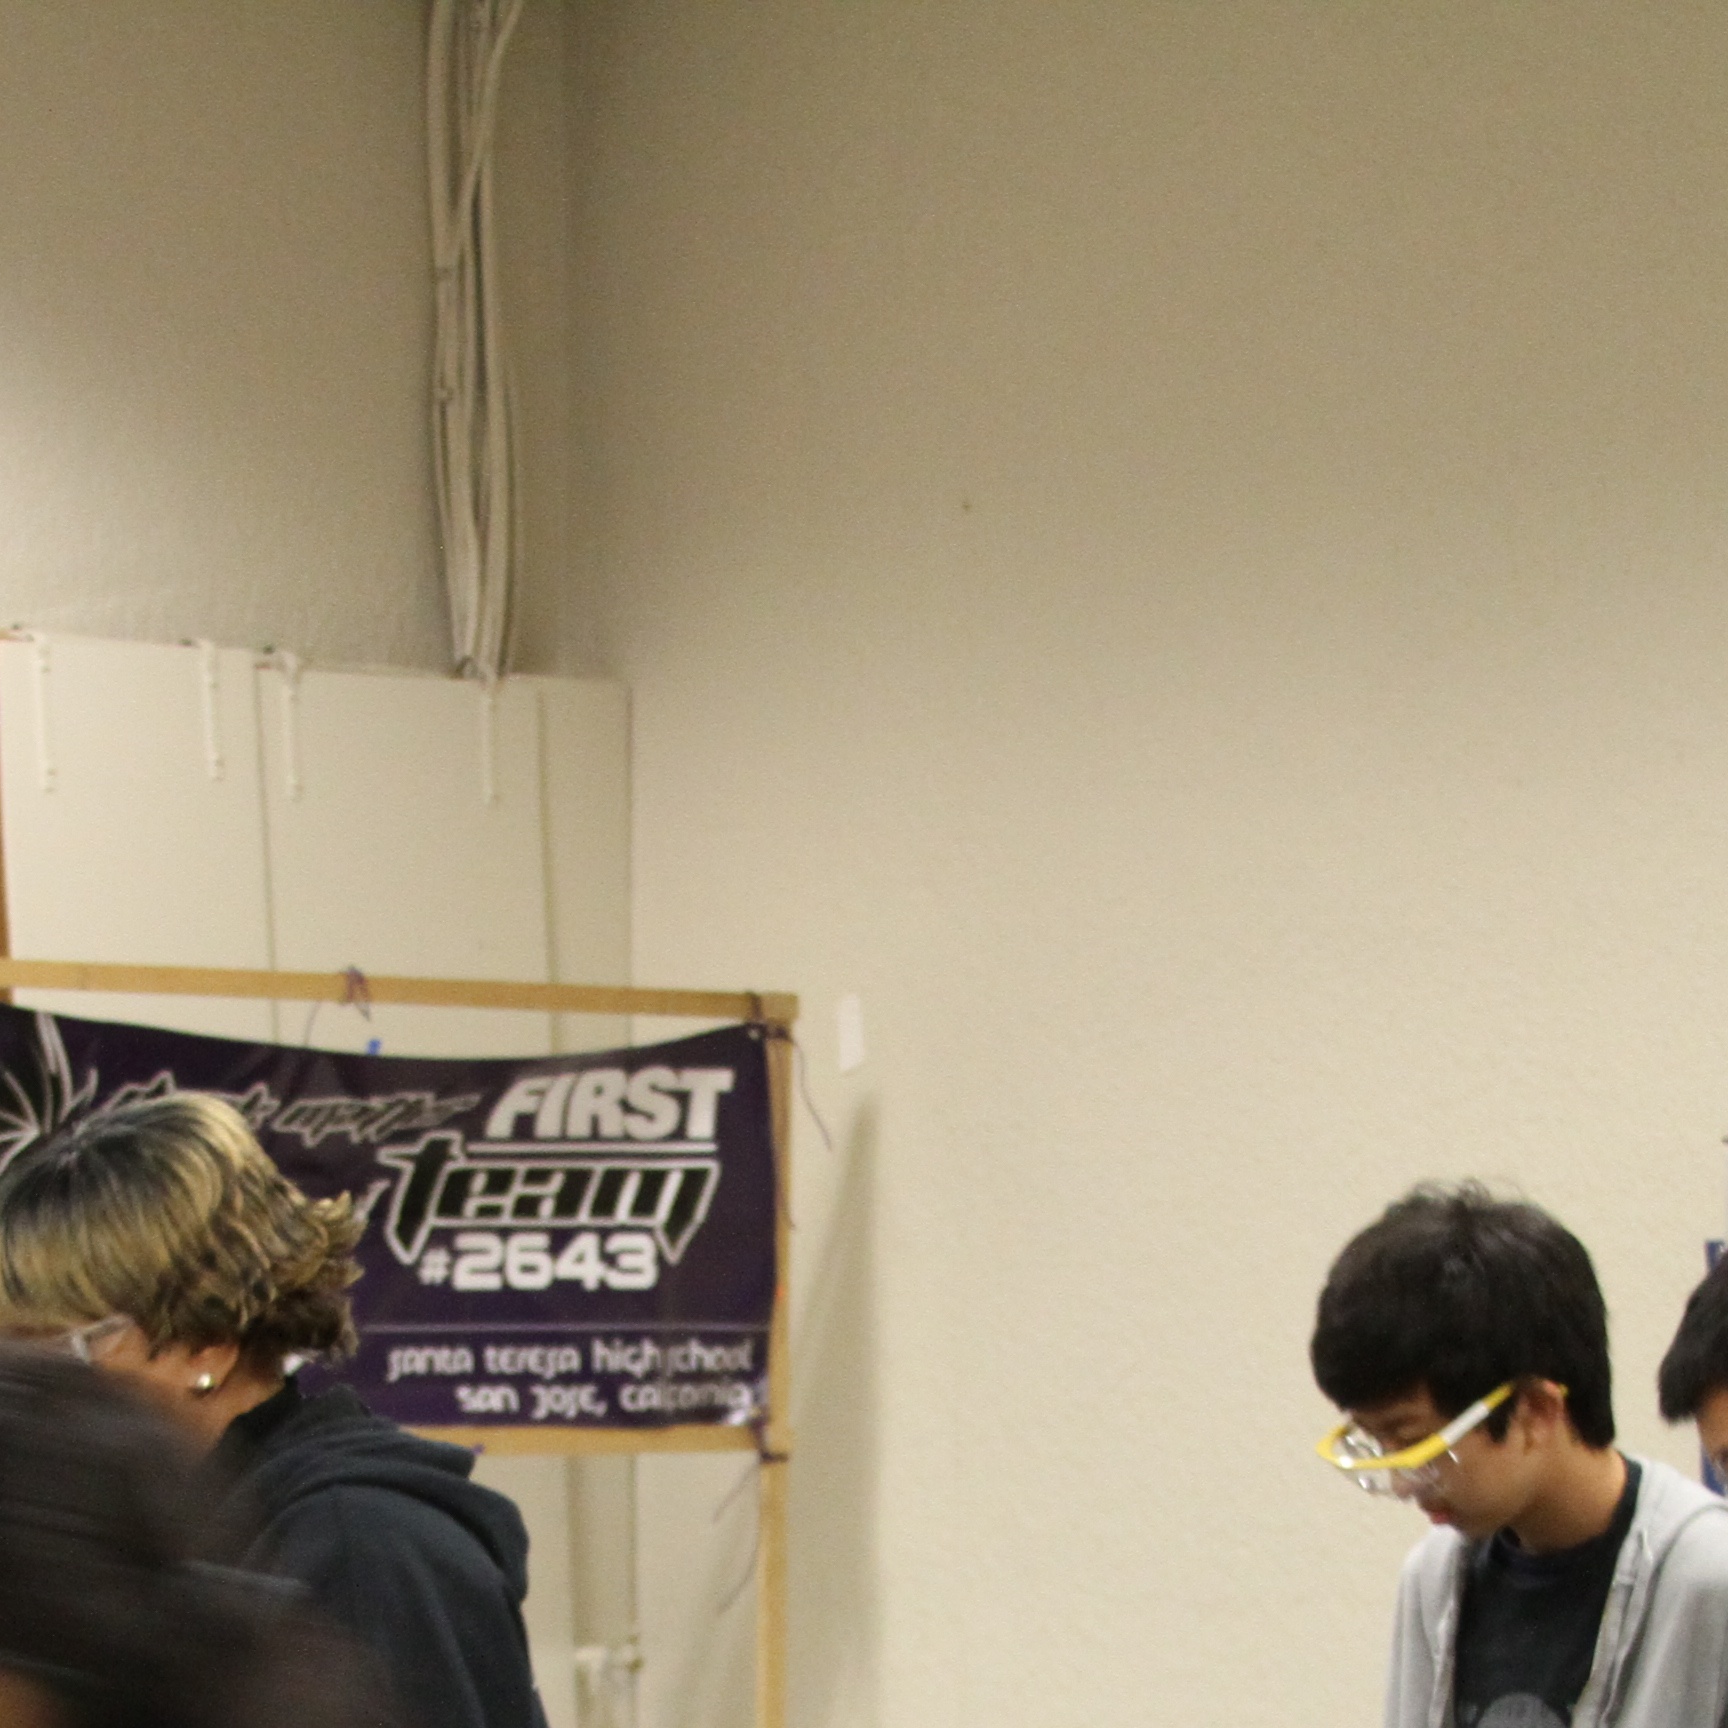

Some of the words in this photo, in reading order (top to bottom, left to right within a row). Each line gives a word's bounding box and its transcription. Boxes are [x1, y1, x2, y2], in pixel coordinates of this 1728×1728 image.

[485, 1066, 734, 1140] FIRST
[377, 1131, 721, 1265] team
[419, 1231, 661, 1291] #2643
[387, 1345, 475, 1383] santa
[483, 1344, 582, 1379] teresa
[591, 1338, 661, 1377] high
[456, 1384, 520, 1414] san
